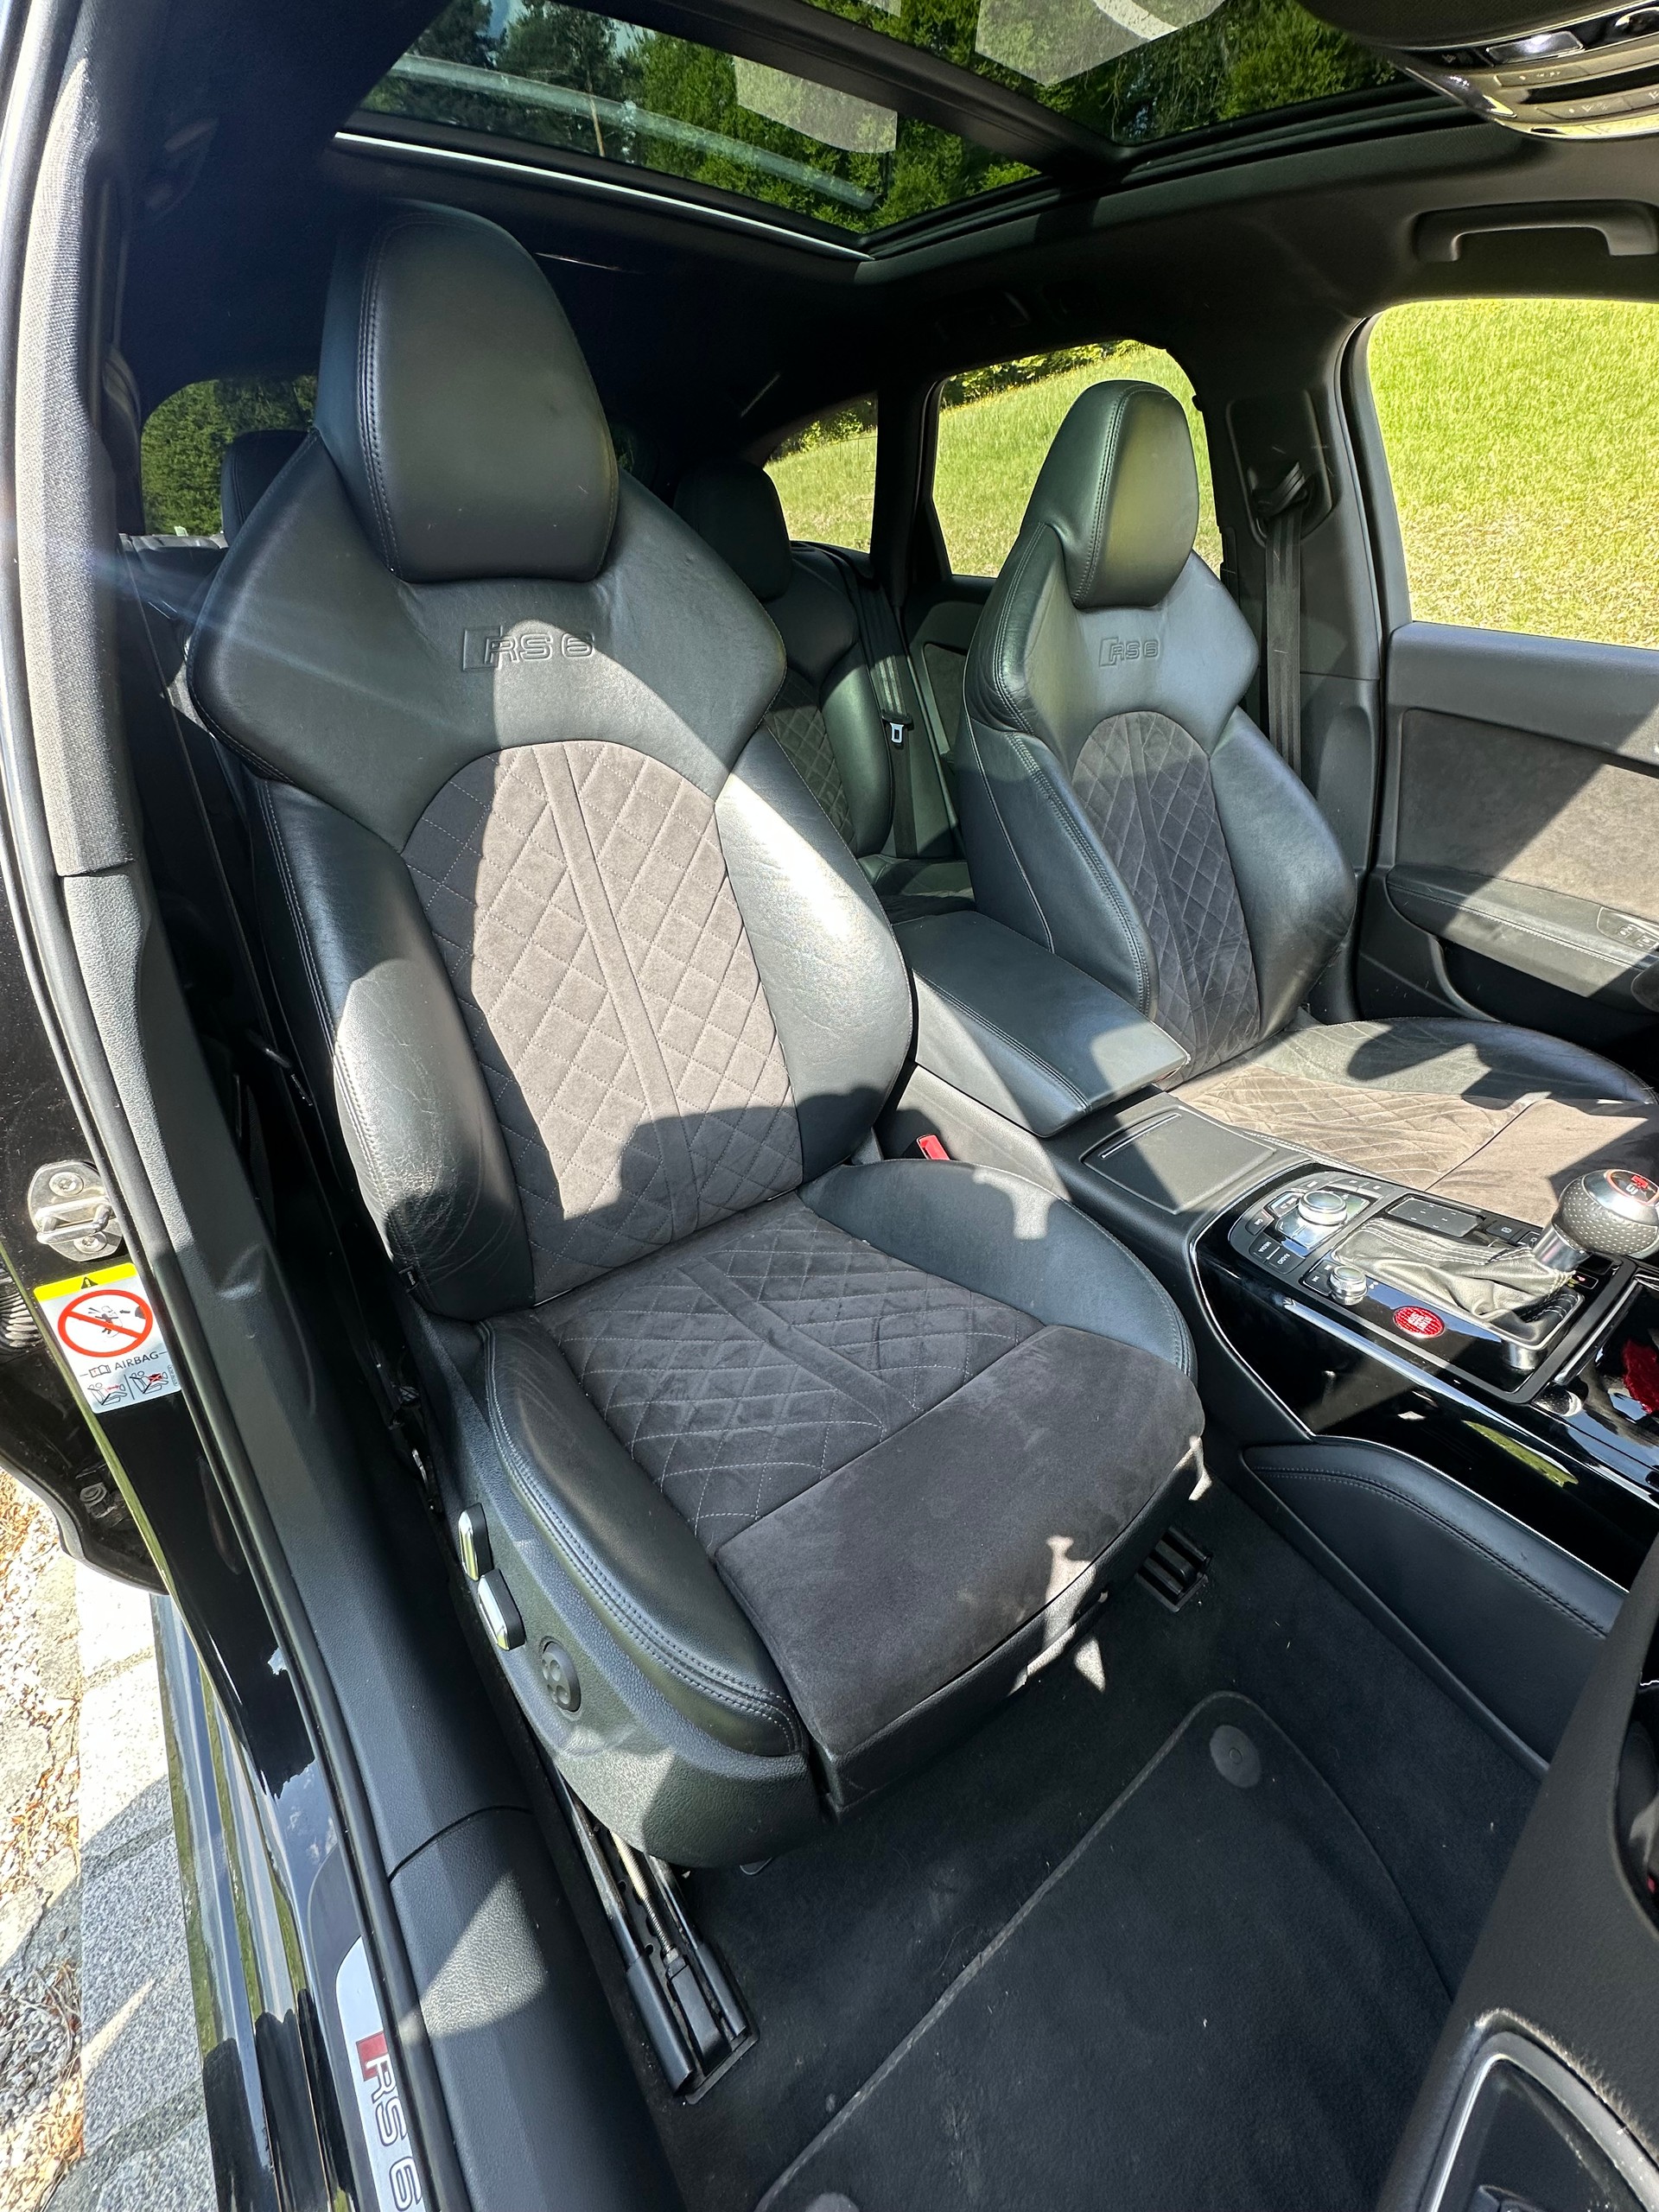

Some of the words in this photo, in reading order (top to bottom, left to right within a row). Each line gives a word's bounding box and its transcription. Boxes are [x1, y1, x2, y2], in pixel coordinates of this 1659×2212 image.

[561, 631, 595, 659] 6
[114, 1351, 160, 1371] AIRBAG
[364, 2052, 409, 2147] RS
[389, 2156, 423, 2212] 6
